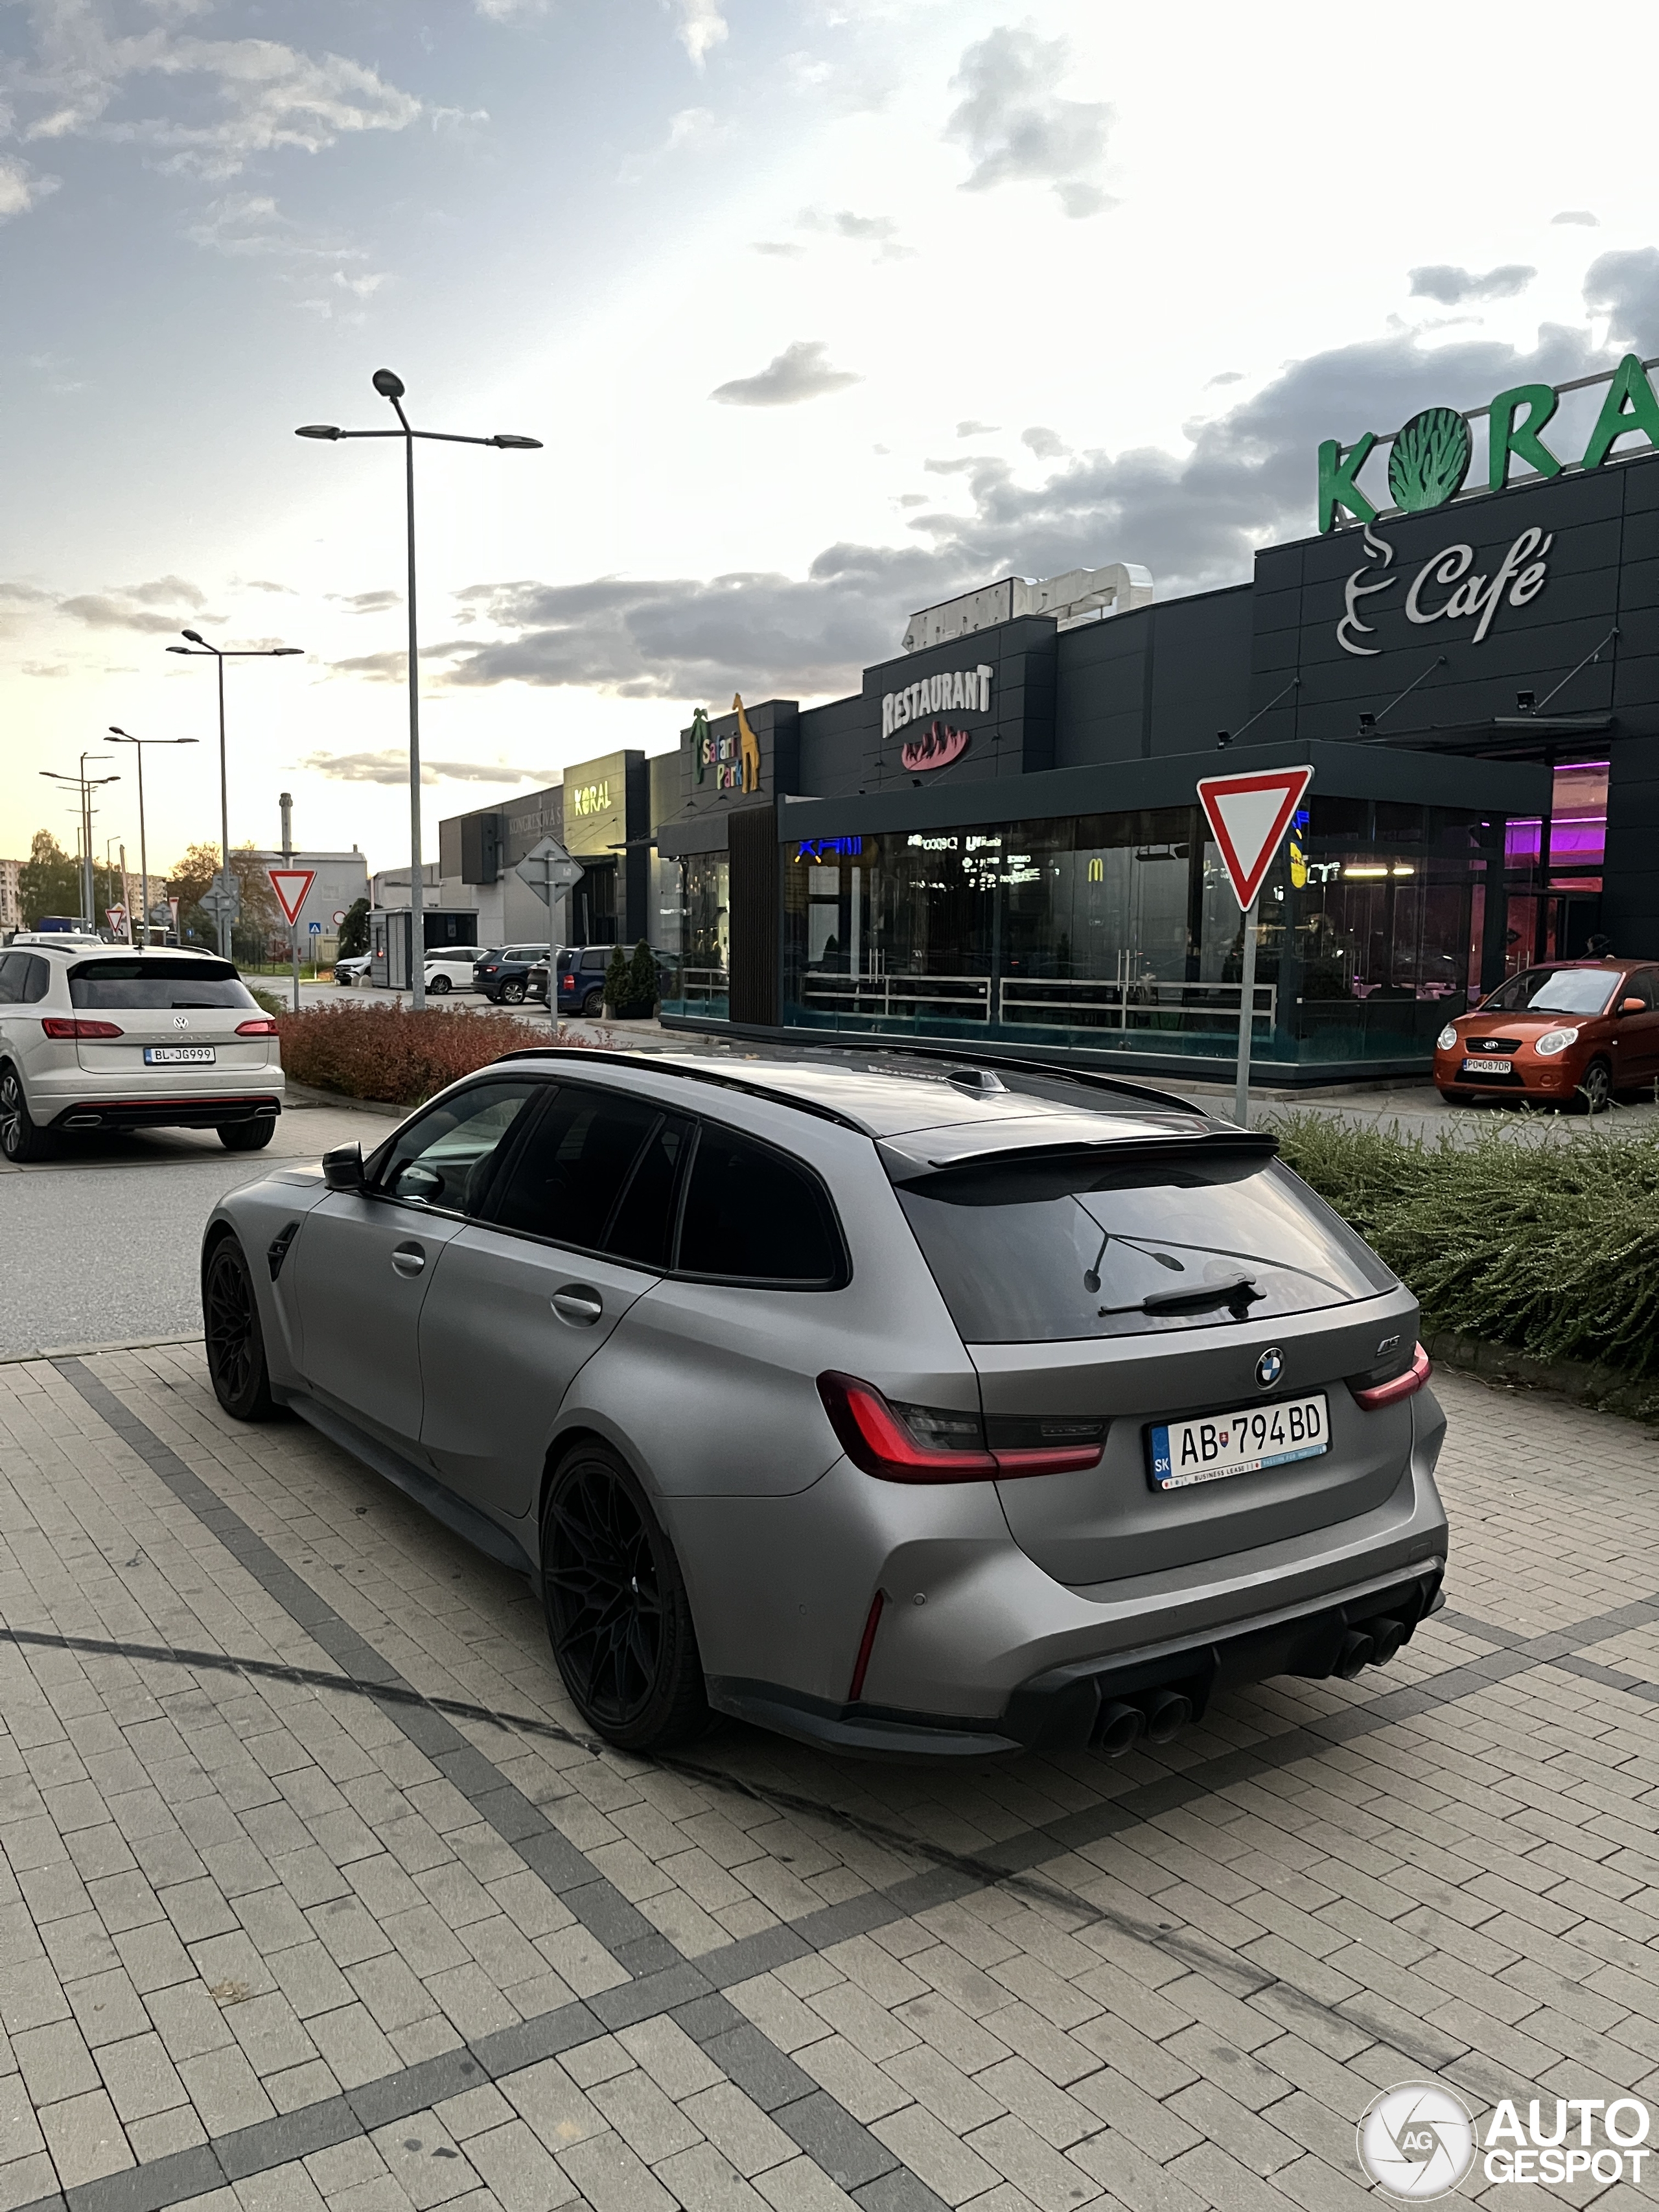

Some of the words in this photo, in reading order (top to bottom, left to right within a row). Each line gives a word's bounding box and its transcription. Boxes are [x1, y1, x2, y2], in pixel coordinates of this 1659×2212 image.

[1405, 527, 1553, 644] Café
[883, 664, 993, 738] RESTAURANT
[702, 734, 736, 765] Safari
[717, 759, 742, 789] Park
[574, 780, 612, 816] KORAL
[156, 1050, 169, 1060] BL
[176, 1049, 211, 1059] JG999
[1181, 1425, 1218, 1466] AB
[1232, 1404, 1320, 1454] 794BD
[1155, 1457, 1170, 1472] SK
[1194, 1469, 1225, 1482] BUSINESS
[1227, 1465, 1245, 1474] LEASE
